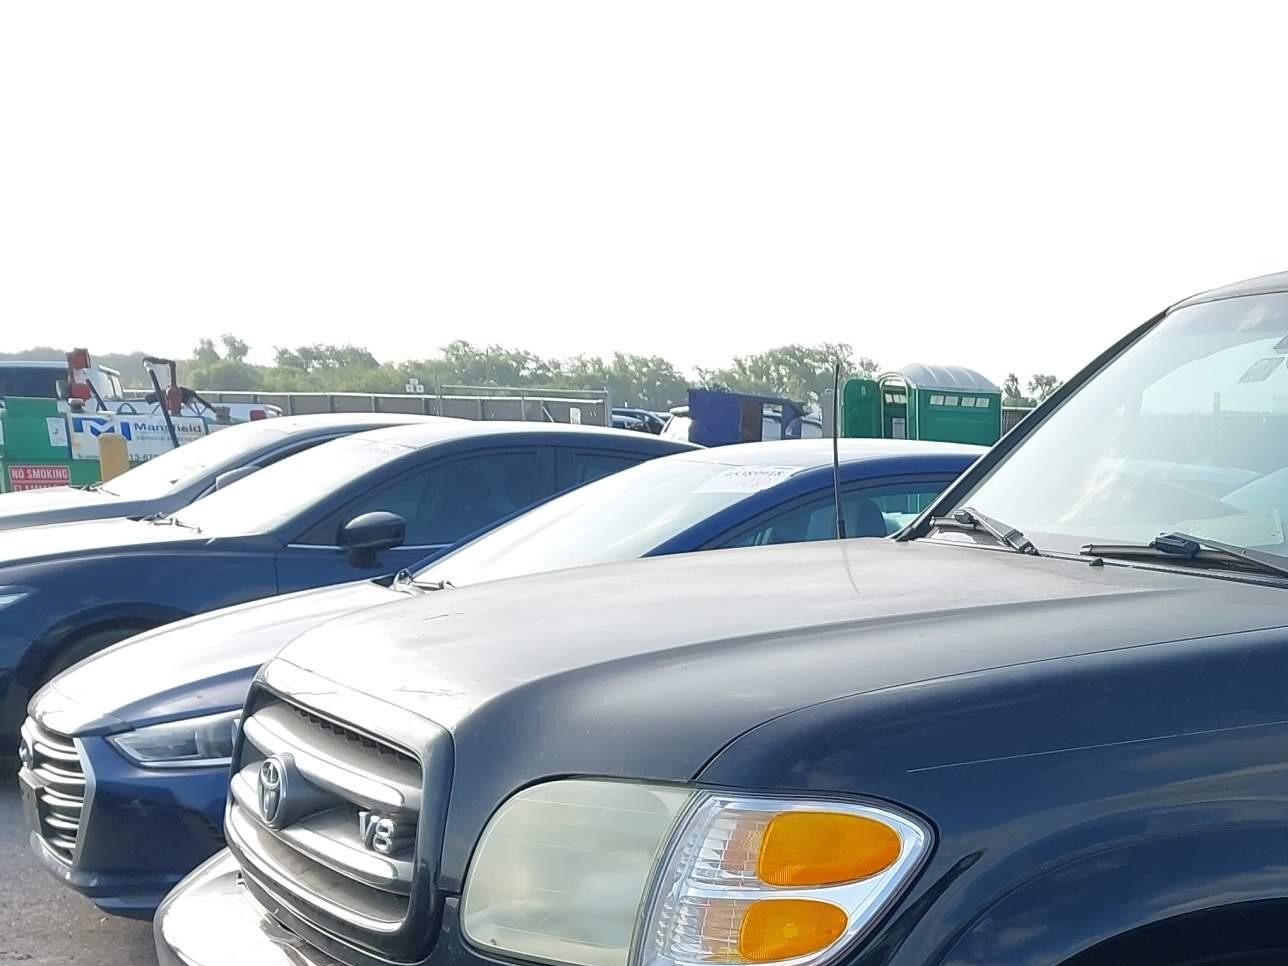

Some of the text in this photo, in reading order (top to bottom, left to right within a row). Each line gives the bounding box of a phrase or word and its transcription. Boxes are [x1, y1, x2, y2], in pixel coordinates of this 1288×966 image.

[11, 468, 68, 479] NO SMOKING
[358, 811, 395, 854] V8
